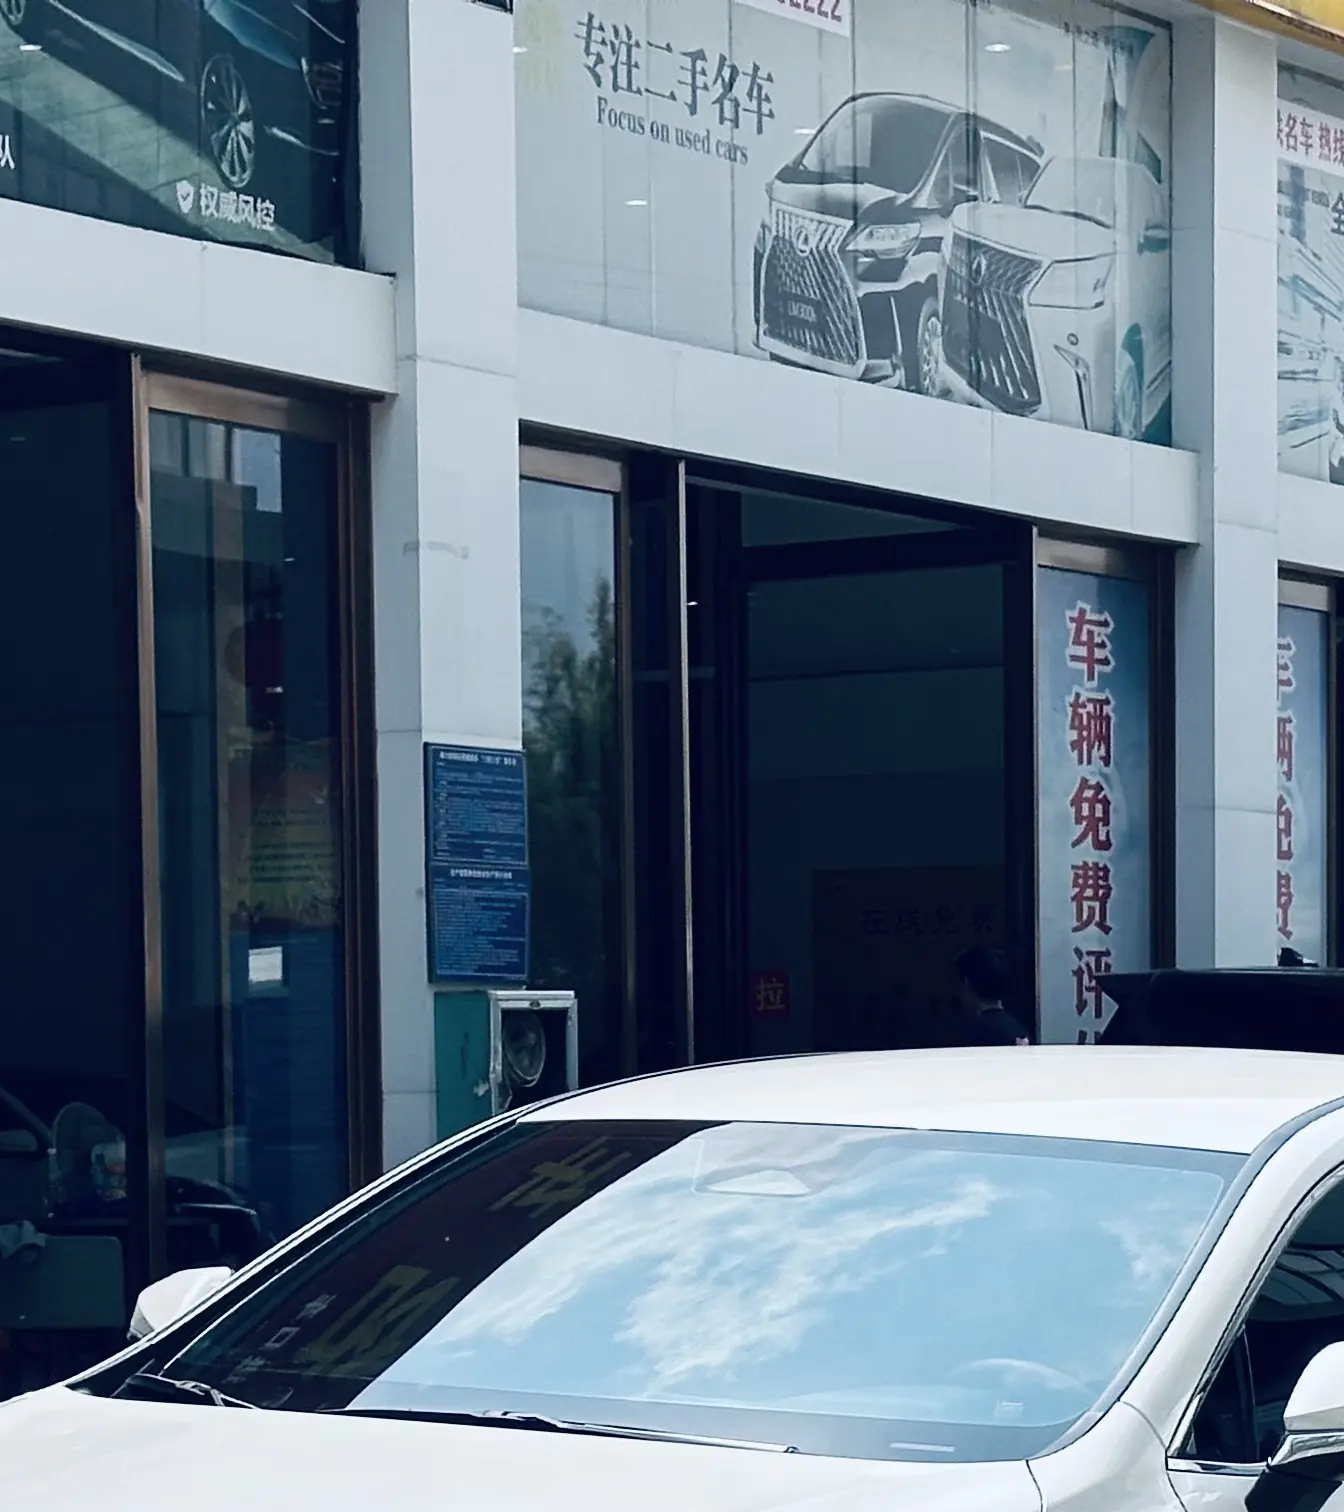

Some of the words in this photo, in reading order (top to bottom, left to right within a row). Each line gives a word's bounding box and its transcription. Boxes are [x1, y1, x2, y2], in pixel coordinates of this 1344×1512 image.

[575, 12, 776, 135] 专注二手名车
[597, 95, 645, 136] Focus
[650, 120, 670, 144] on
[675, 127, 711, 155] used
[716, 139, 749, 166] cars
[199, 182, 276, 232] 权威风控
[1066, 602, 1114, 1044] 车辆免费评
[754, 977, 786, 1012] 拉
